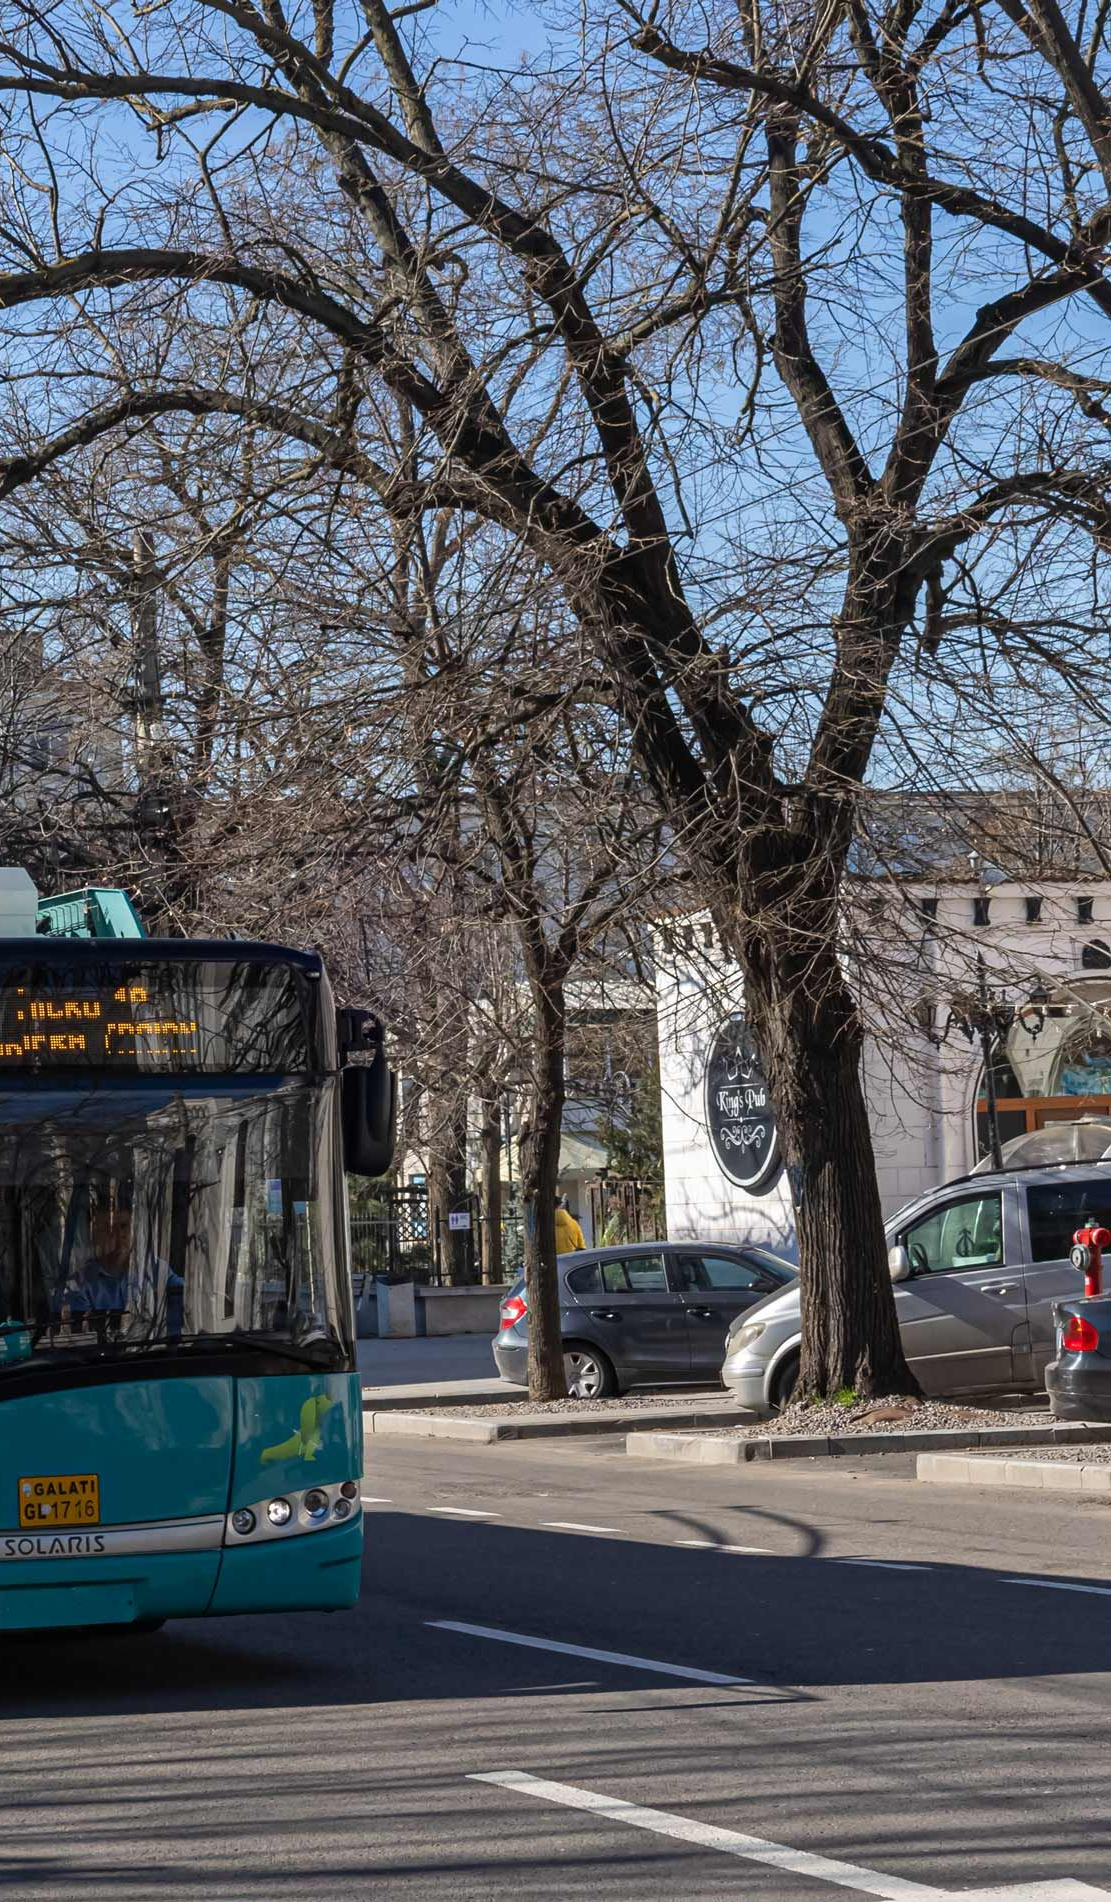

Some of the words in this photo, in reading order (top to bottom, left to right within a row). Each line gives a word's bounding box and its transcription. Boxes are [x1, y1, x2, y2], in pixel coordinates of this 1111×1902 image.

[716, 1089, 743, 1118] King's
[744, 1087, 766, 1116] Pub
[4, 1534, 106, 1557] SOLARIS
